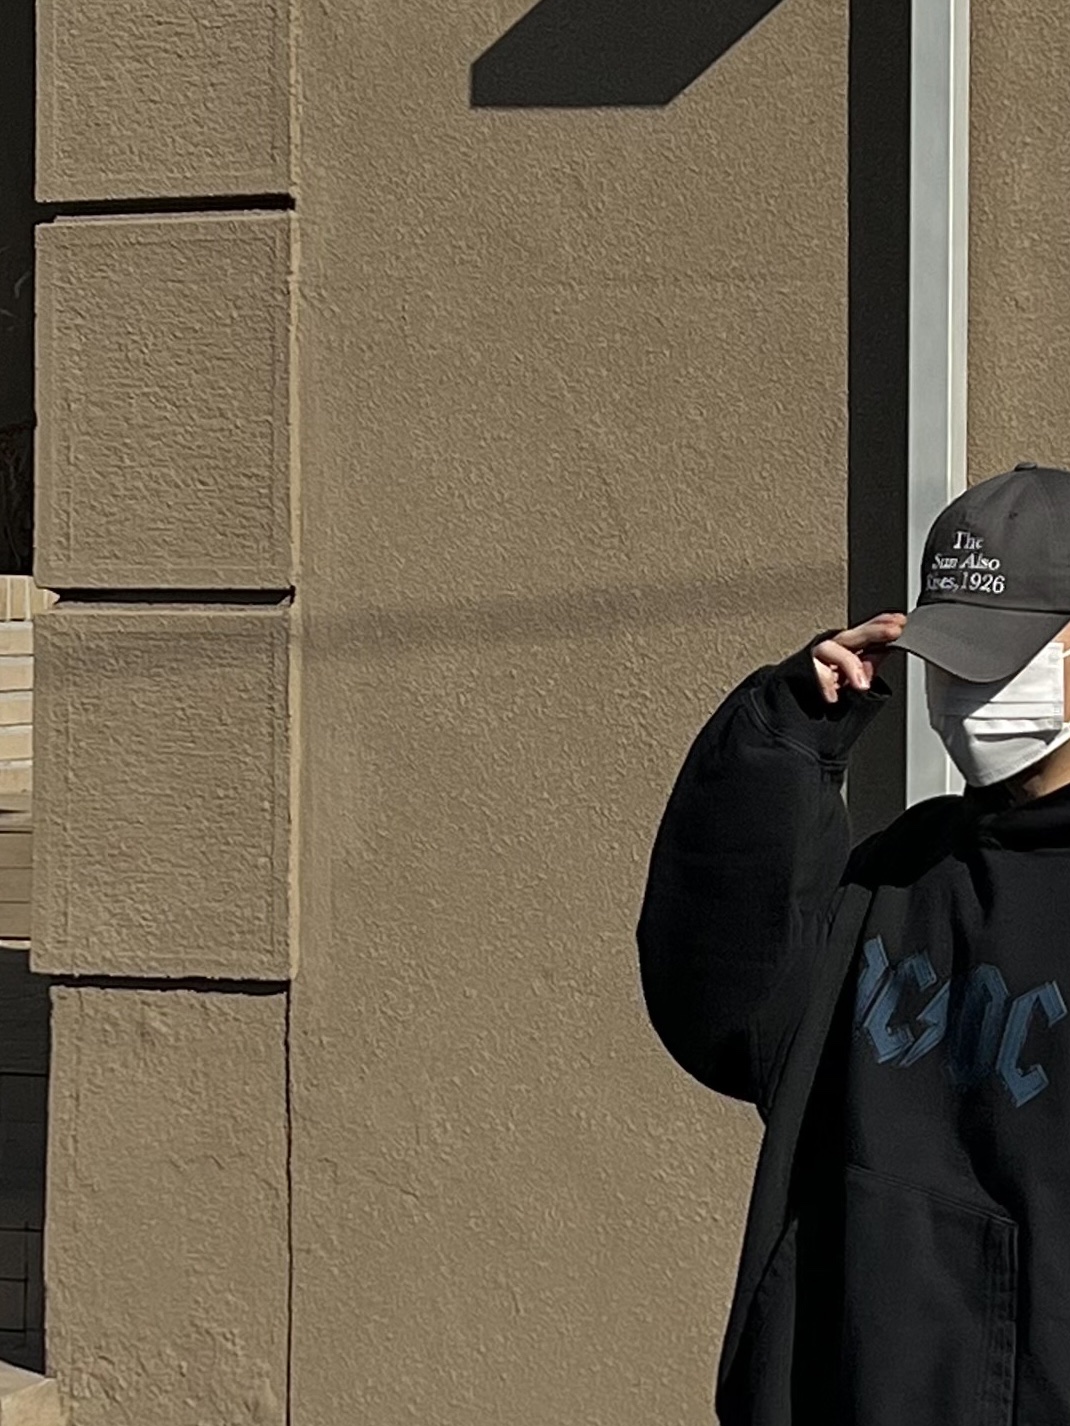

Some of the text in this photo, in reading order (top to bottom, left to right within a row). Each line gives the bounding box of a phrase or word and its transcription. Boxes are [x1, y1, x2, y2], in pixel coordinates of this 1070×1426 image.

[952, 530, 985, 550] The
[931, 552, 1001, 571] Sun Also
